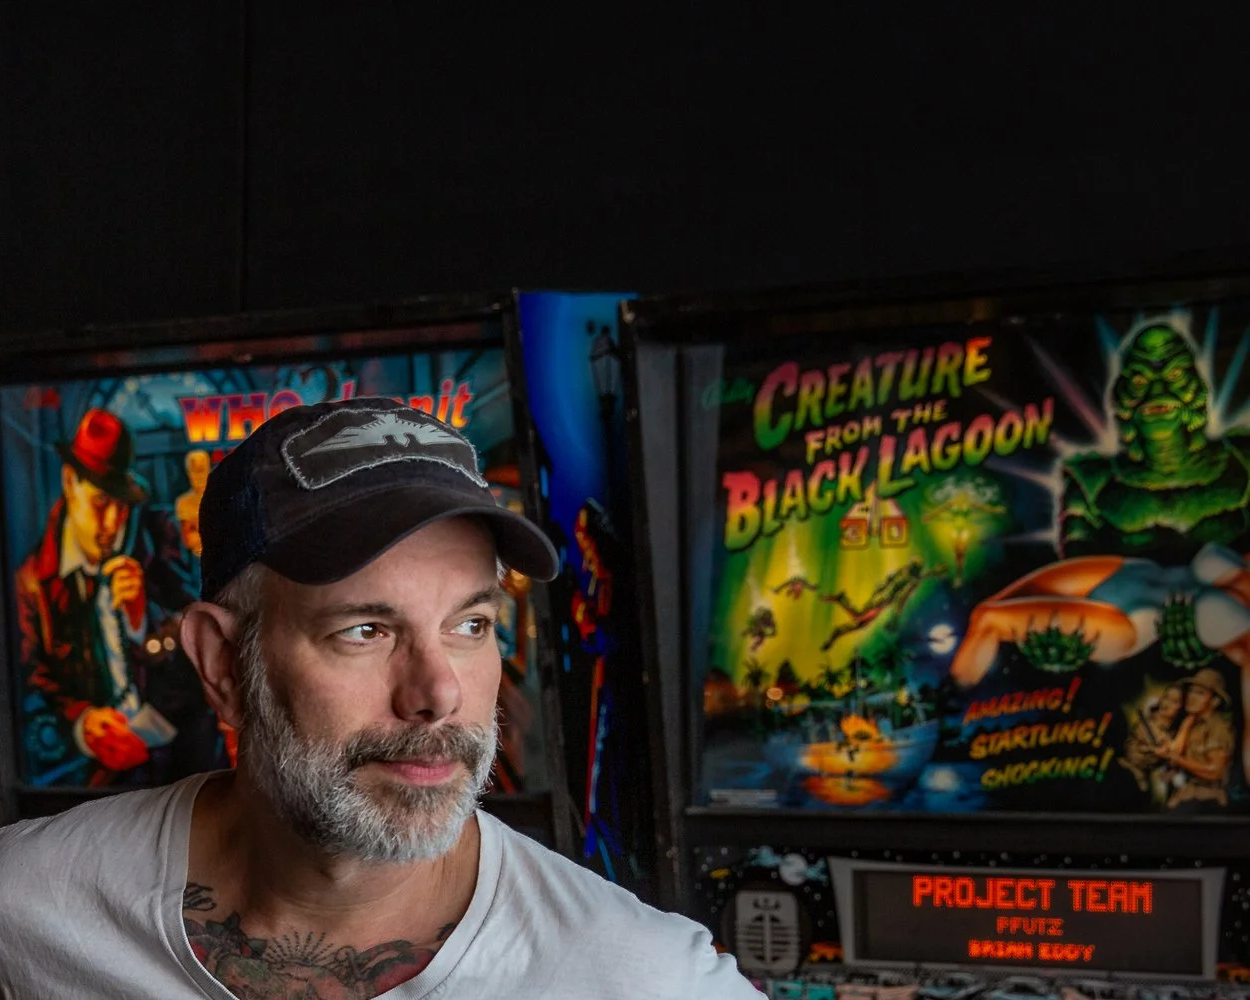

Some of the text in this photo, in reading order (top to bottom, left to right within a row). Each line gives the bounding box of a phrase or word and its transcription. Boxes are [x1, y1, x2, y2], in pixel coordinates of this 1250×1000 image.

[753, 335, 994, 451] CREATURE
[804, 398, 949, 465] FROM THE
[722, 395, 1056, 552] BLACK LAGOON
[962, 676, 1083, 725] AMAZING!
[969, 711, 1114, 760] STARTLING!
[980, 746, 1116, 791] SHOCKING!
[912, 875, 1154, 914] PROJECT TEAM
